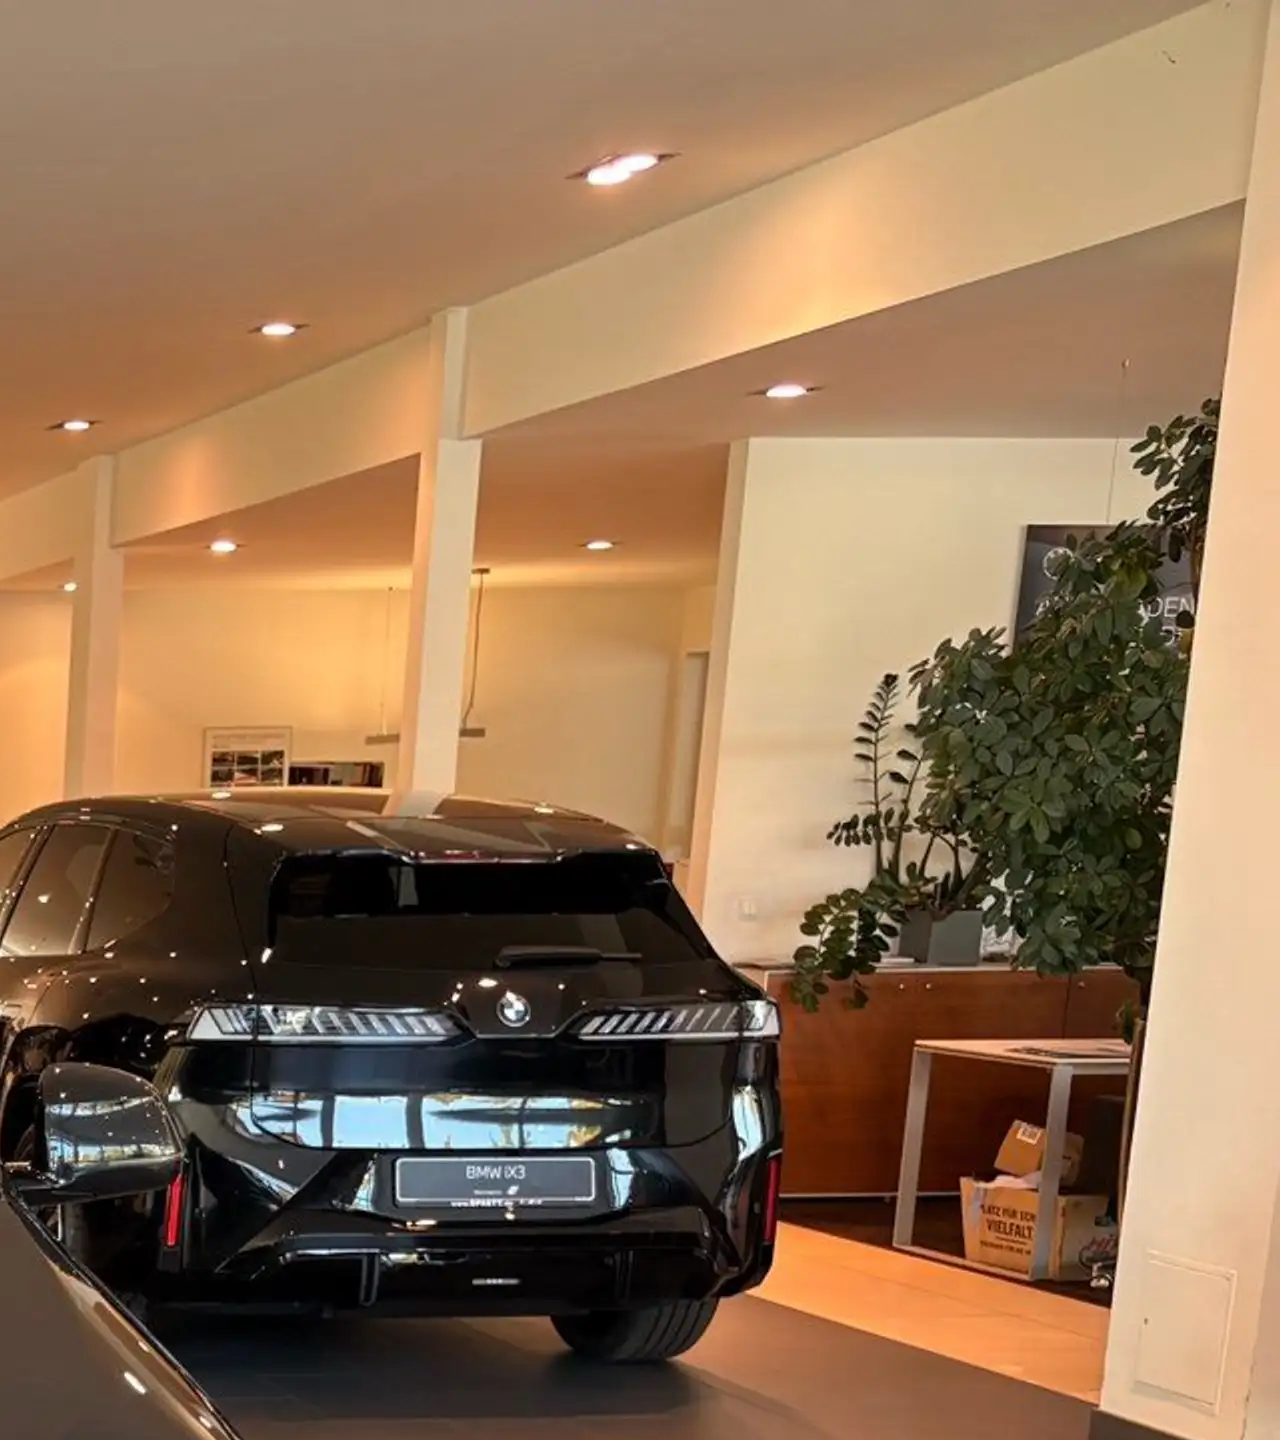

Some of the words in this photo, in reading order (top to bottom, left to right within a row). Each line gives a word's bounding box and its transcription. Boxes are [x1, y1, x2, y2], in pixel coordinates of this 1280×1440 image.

[466, 1164, 502, 1180] BMW
[504, 1164, 526, 1180] iX3
[986, 1218, 1034, 1240] VIELFALT
